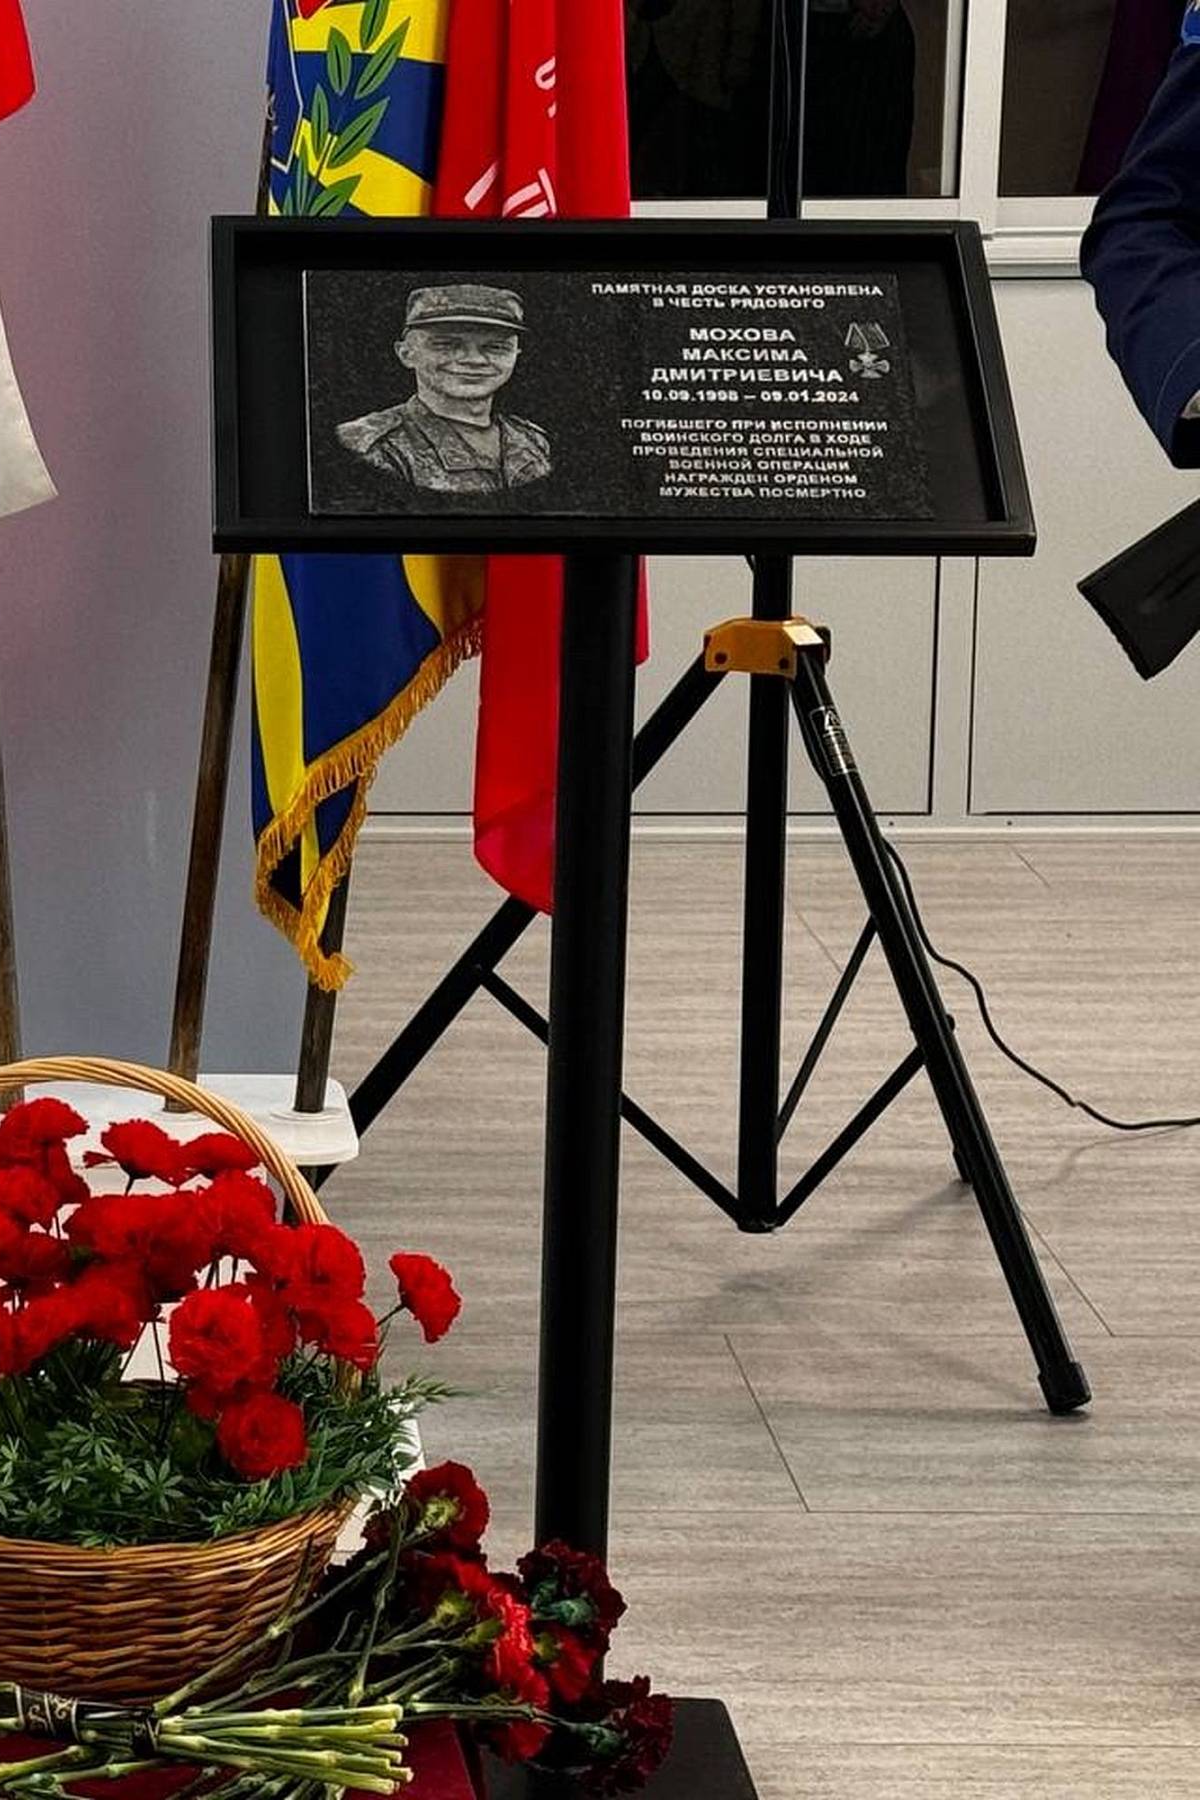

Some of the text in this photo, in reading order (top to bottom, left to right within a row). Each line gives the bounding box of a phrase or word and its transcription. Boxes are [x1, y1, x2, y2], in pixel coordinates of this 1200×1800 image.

[591, 284, 883, 297] ПАМЯТНАЯ ДОСКА УСТАНОВЛЕНА
[652, 298, 825, 310] В ЧЕСТЬ РЯДОВОГО
[689, 328, 796, 342] МОХОВА
[682, 348, 808, 362] МАКСИМА
[651, 369, 843, 383] ДМИТРИЕВИЧА
[760, 390, 859, 403] 09.01.2024
[621, 419, 888, 431] ПОГИБШЕГО ПРИ ИСПОЛНЕНИИ
[640, 433, 871, 445] ВОИНСКОГО ДОЛГА В ХОДЕ
[632, 445, 884, 459] ПРОВЕДЕНИЯ СПЕЦИАЛЬНОЙ
[668, 457, 850, 472] ВОЕННОЙ ОПЕРАЦИИ
[664, 473, 858, 485] НАГРАЖДЕН ОРДЕНОМ
[659, 486, 866, 498] МУЖЕСТВА ПОСМЕРТНО
